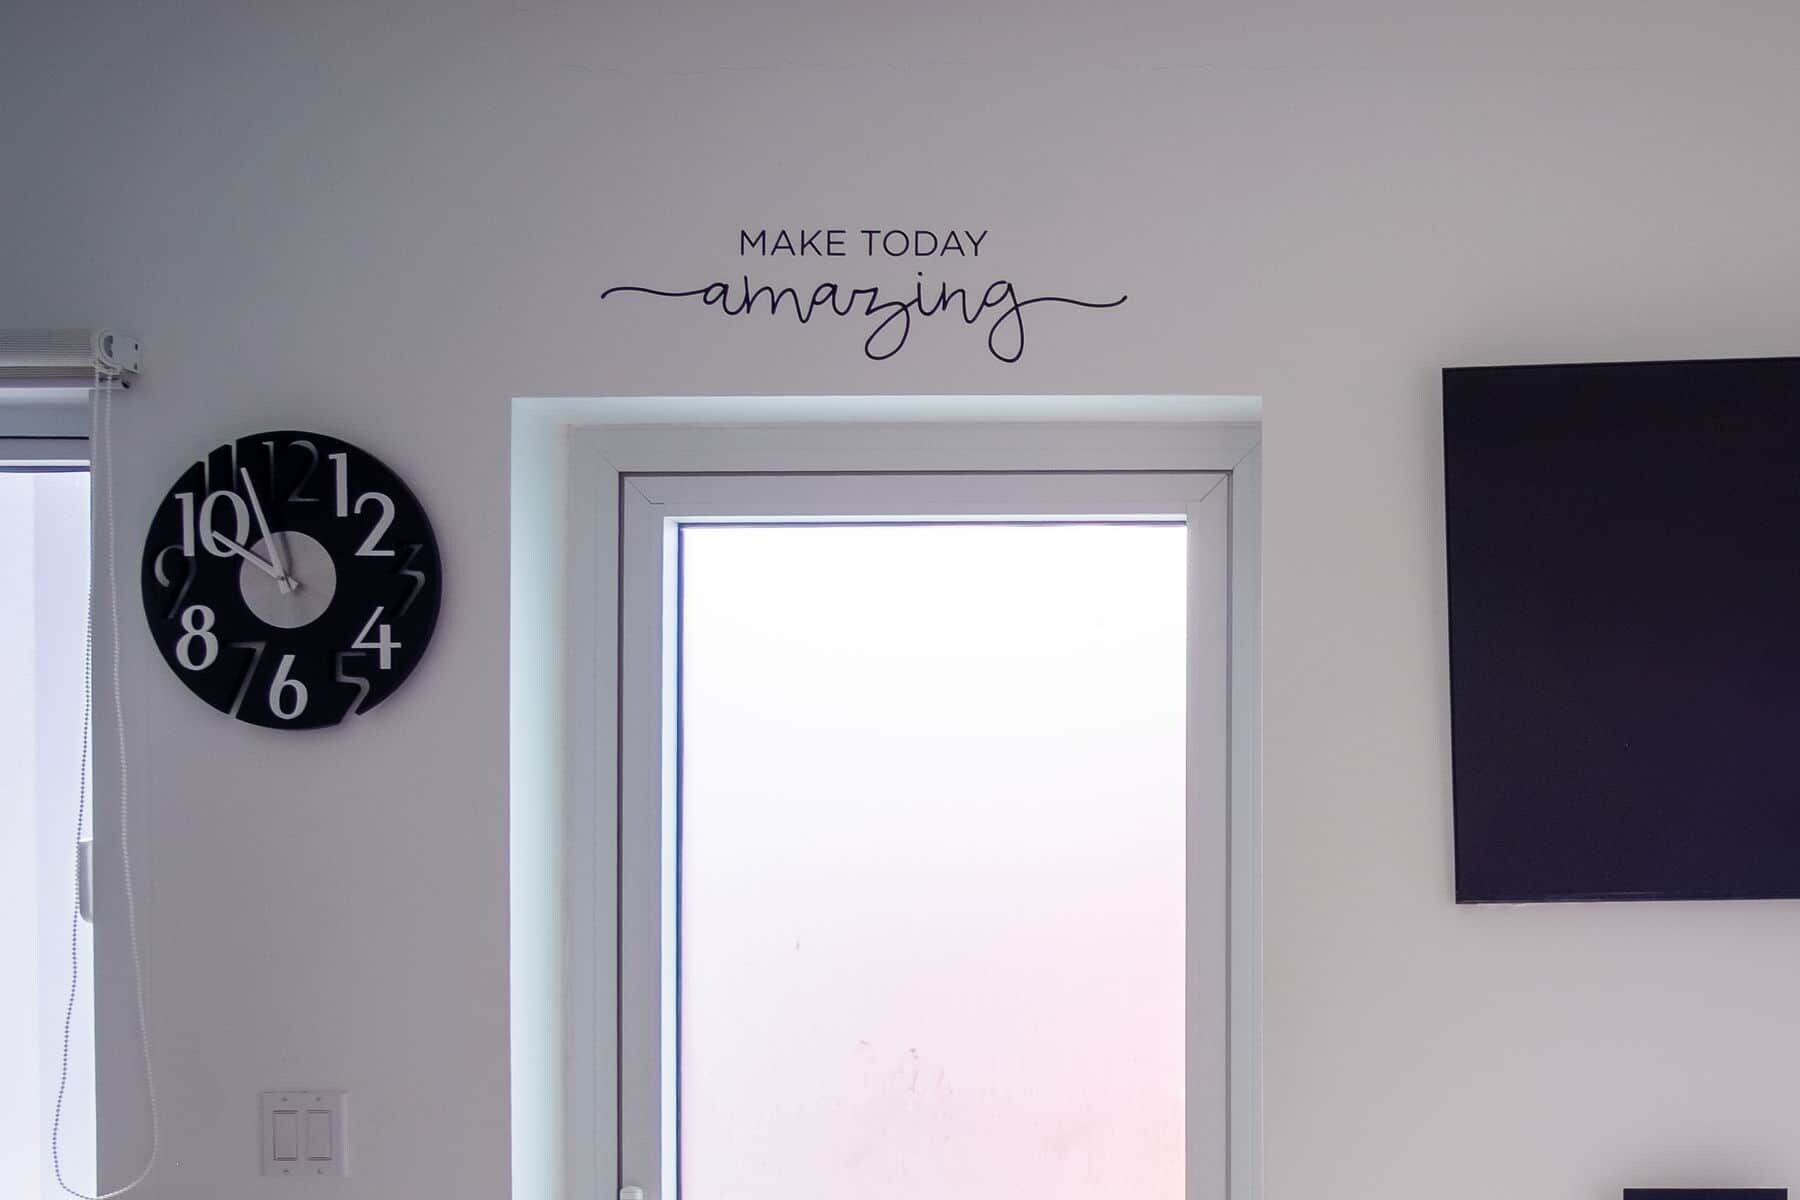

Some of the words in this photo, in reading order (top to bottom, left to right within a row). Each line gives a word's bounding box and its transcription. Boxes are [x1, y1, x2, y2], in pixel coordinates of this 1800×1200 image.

[741, 229, 847, 257] MAKE
[860, 229, 989, 257] TODAY
[600, 271, 1128, 364] amazing
[262, 440, 321, 503] 12
[174, 490, 251, 558] 10
[398, 544, 427, 617] 3
[175, 604, 220, 672] 8
[350, 605, 402, 670] 4
[227, 642, 267, 721] 7
[268, 653, 309, 721] 6
[334, 651, 372, 725] 5
